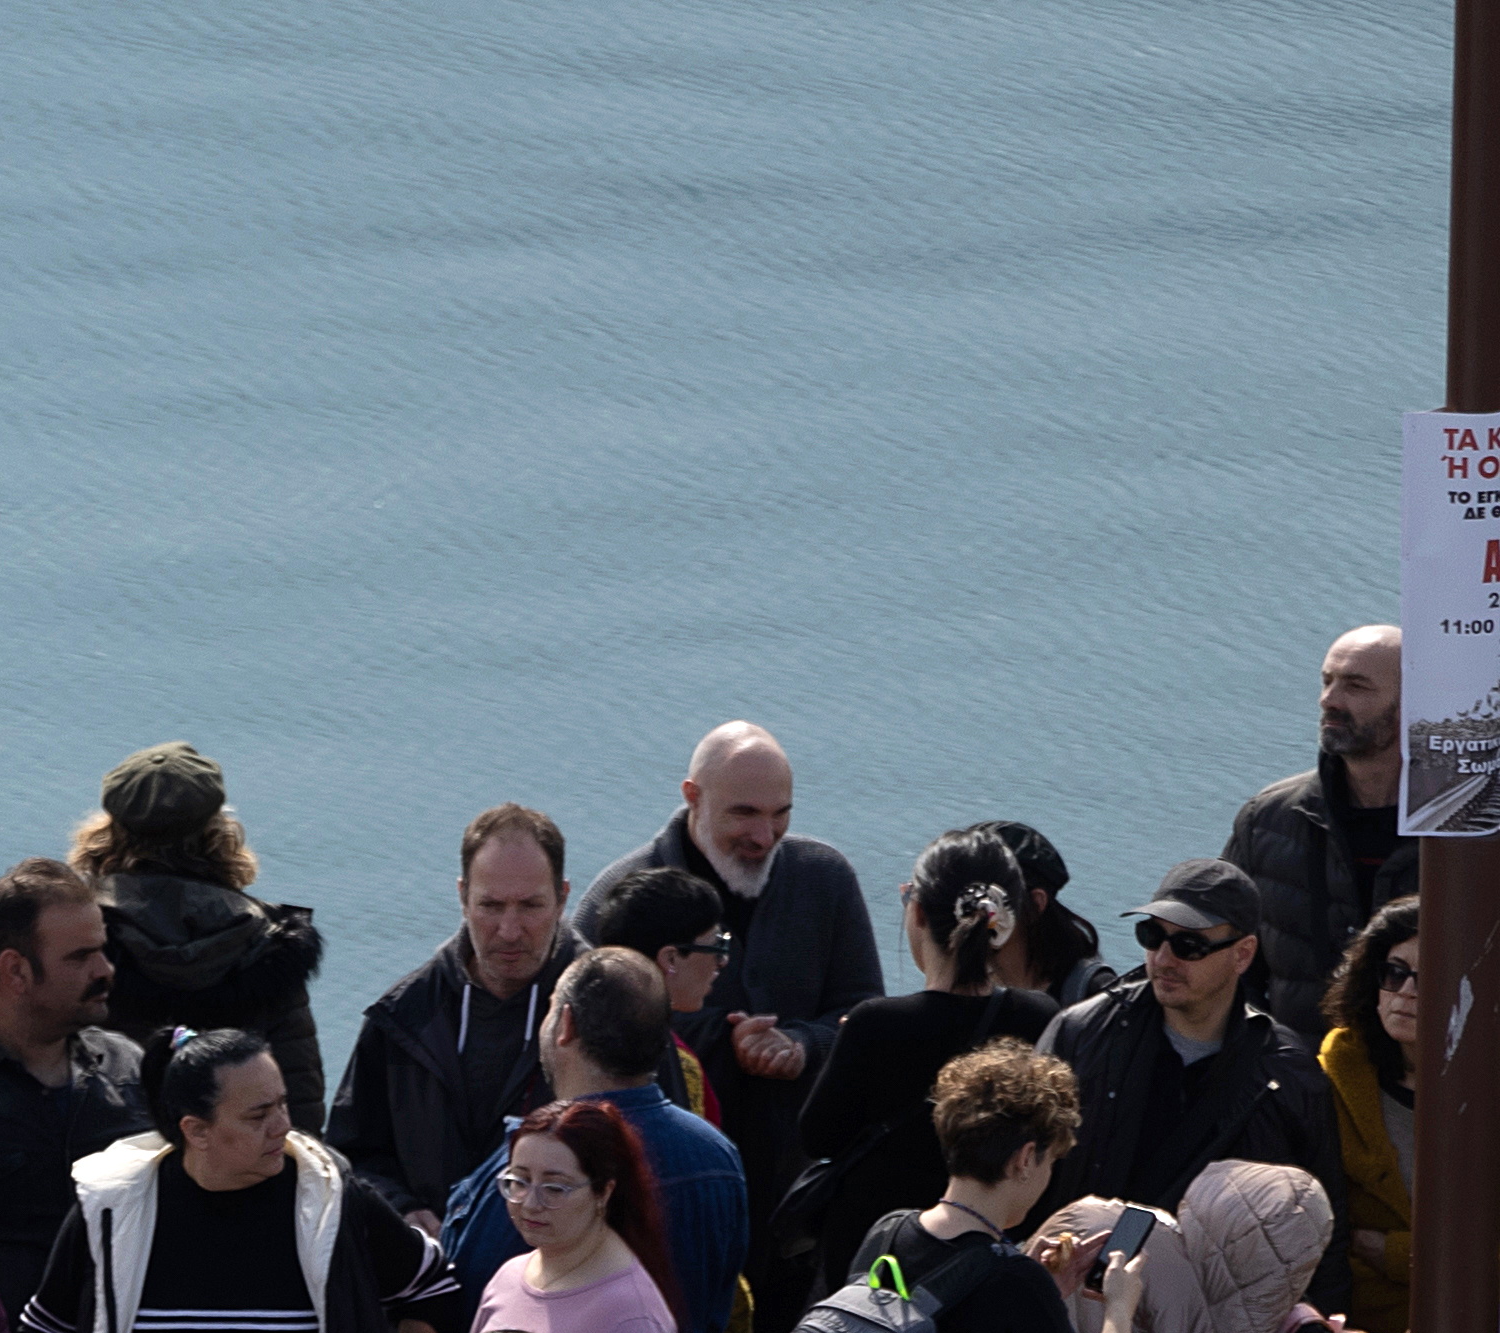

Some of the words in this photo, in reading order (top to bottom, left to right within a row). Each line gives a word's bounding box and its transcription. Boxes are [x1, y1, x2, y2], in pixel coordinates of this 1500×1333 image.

[1443, 428, 1479, 451] ΤΑ
[1448, 490, 1471, 504] ΤΟ
[1463, 507, 1486, 520] ΔΕ
[1440, 619, 1494, 635] 11:00
